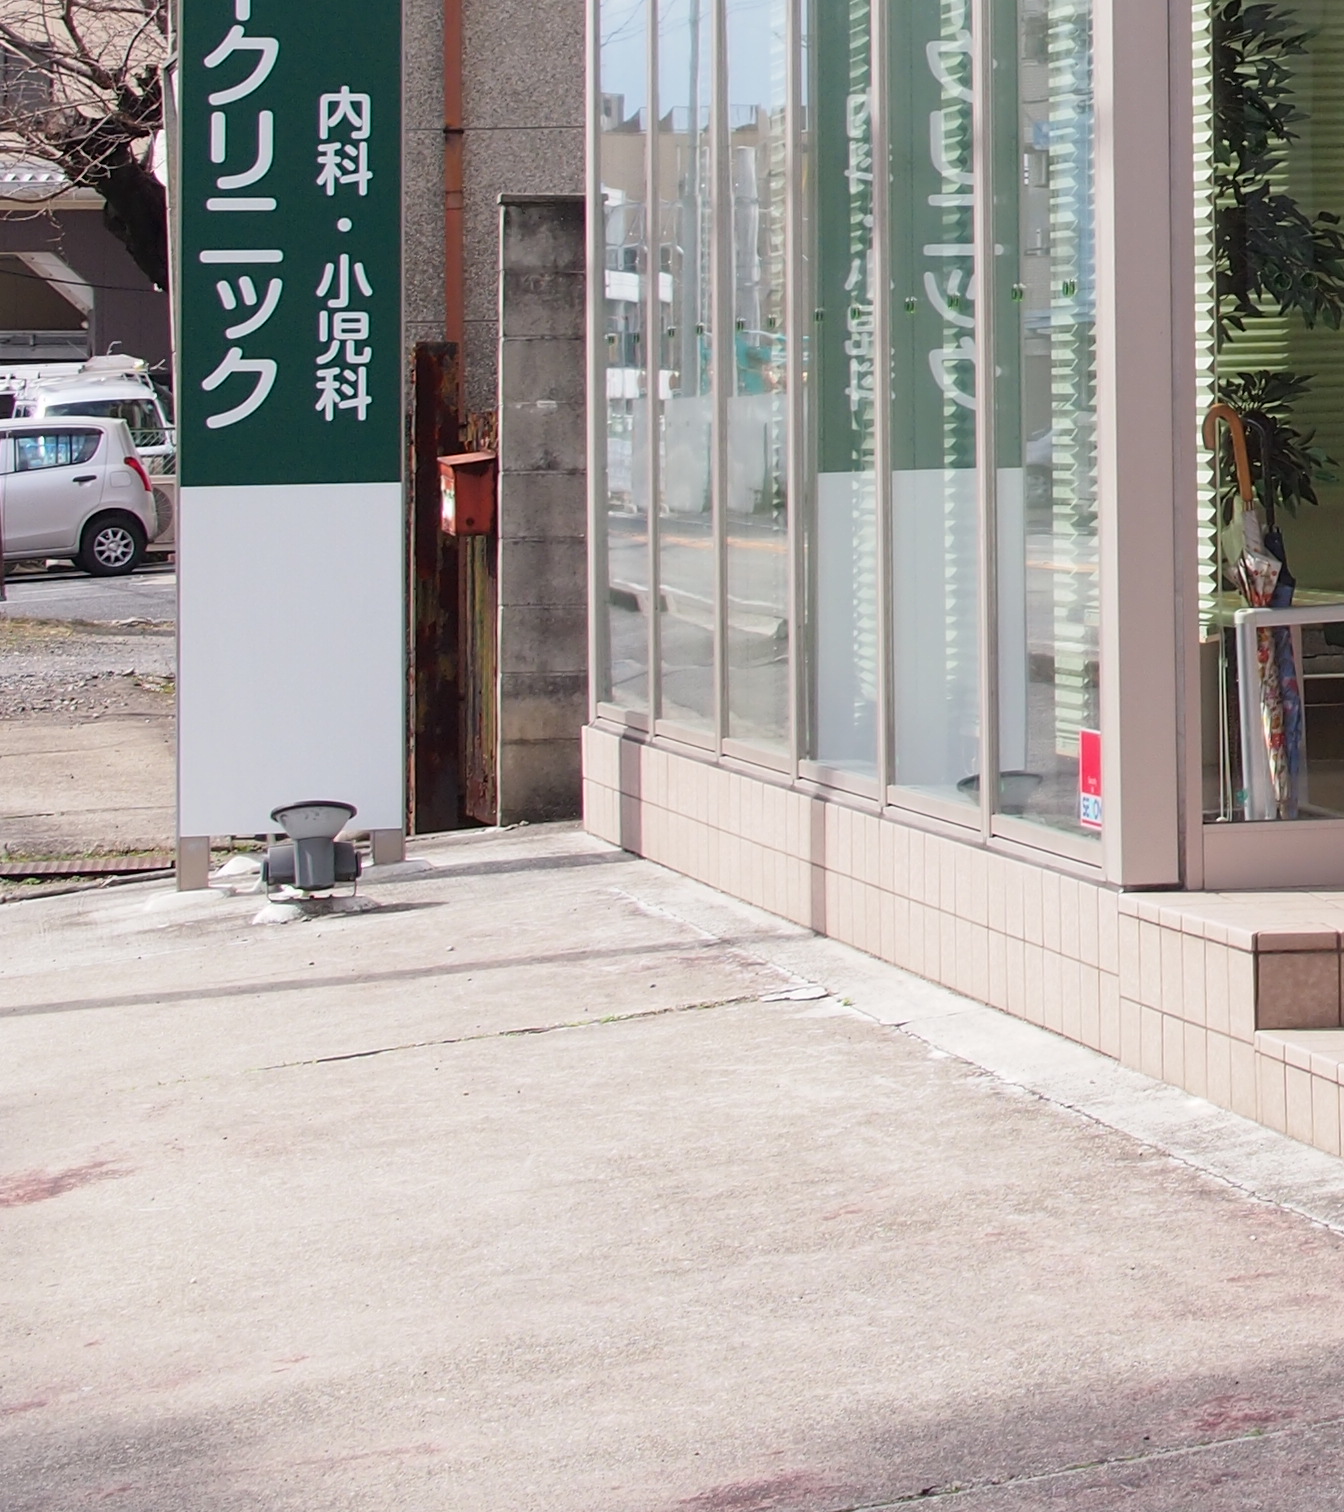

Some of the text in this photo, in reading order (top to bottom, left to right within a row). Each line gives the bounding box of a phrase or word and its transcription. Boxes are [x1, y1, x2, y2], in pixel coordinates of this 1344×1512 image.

[315, 86, 373, 421] 内科・小児科
